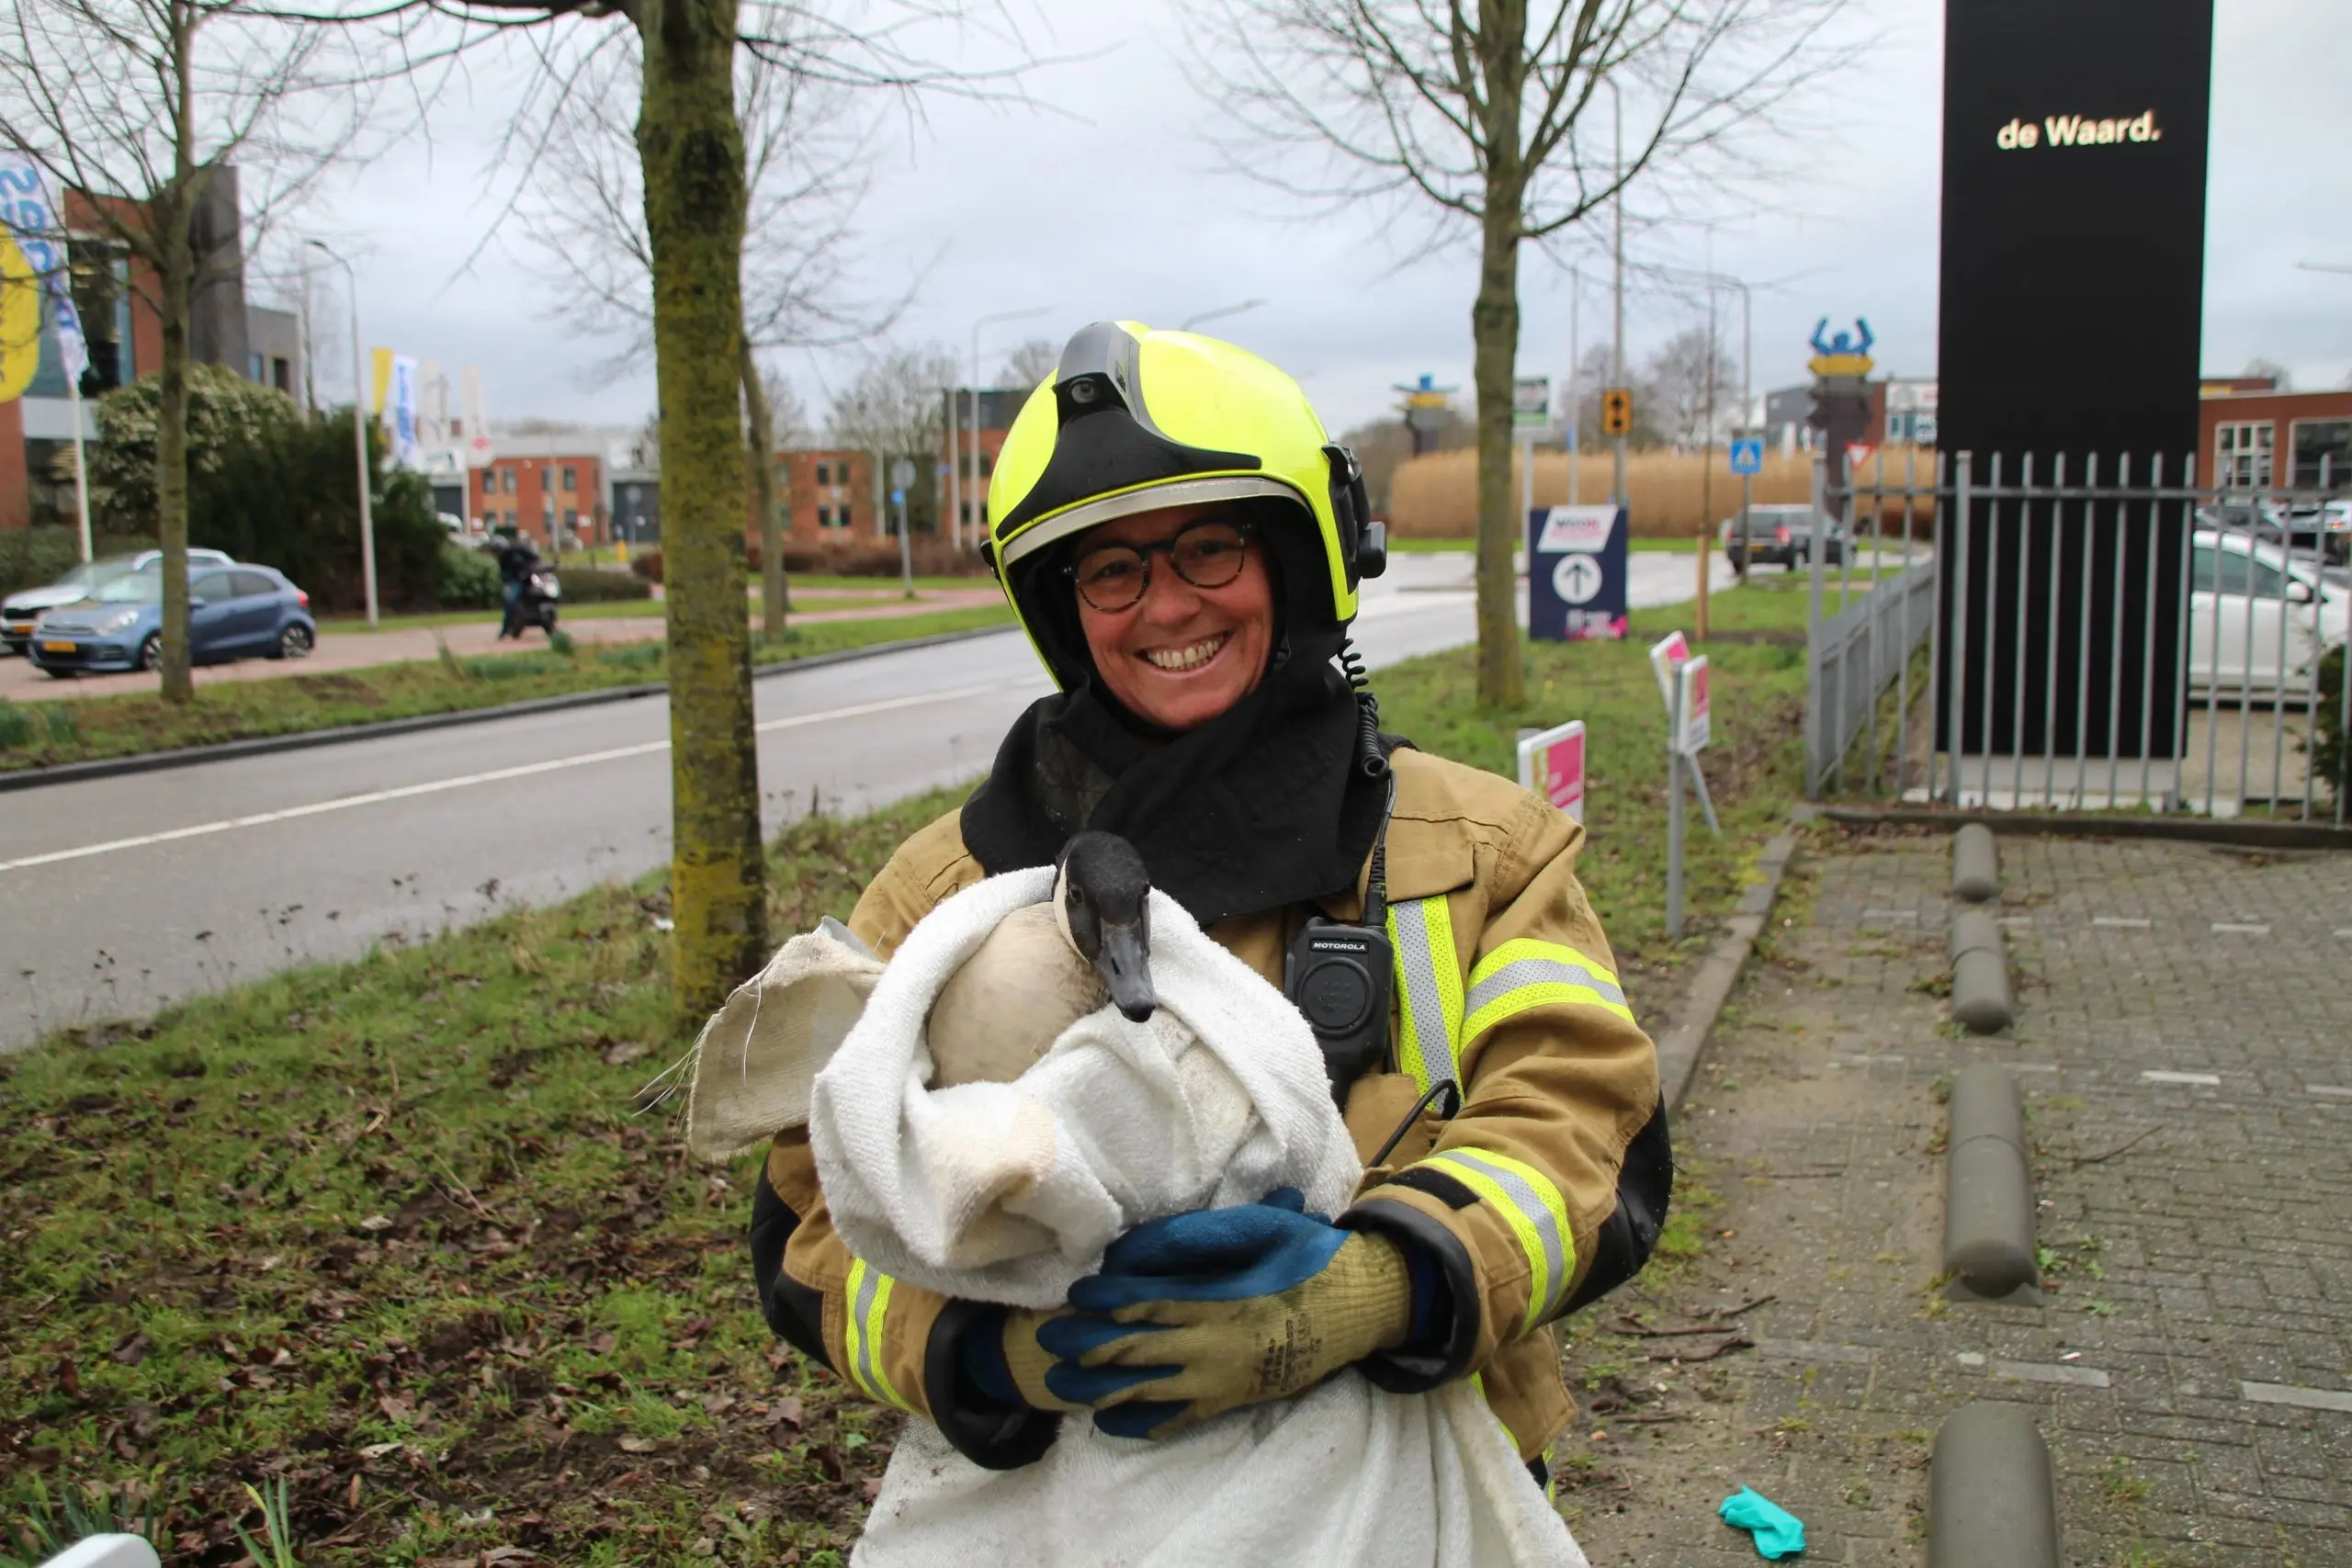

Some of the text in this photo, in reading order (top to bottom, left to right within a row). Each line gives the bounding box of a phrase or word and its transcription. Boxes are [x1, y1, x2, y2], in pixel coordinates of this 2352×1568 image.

[1996, 108, 2163, 150] de Waard.
[1313, 942, 1365, 950] MOTOROLA
